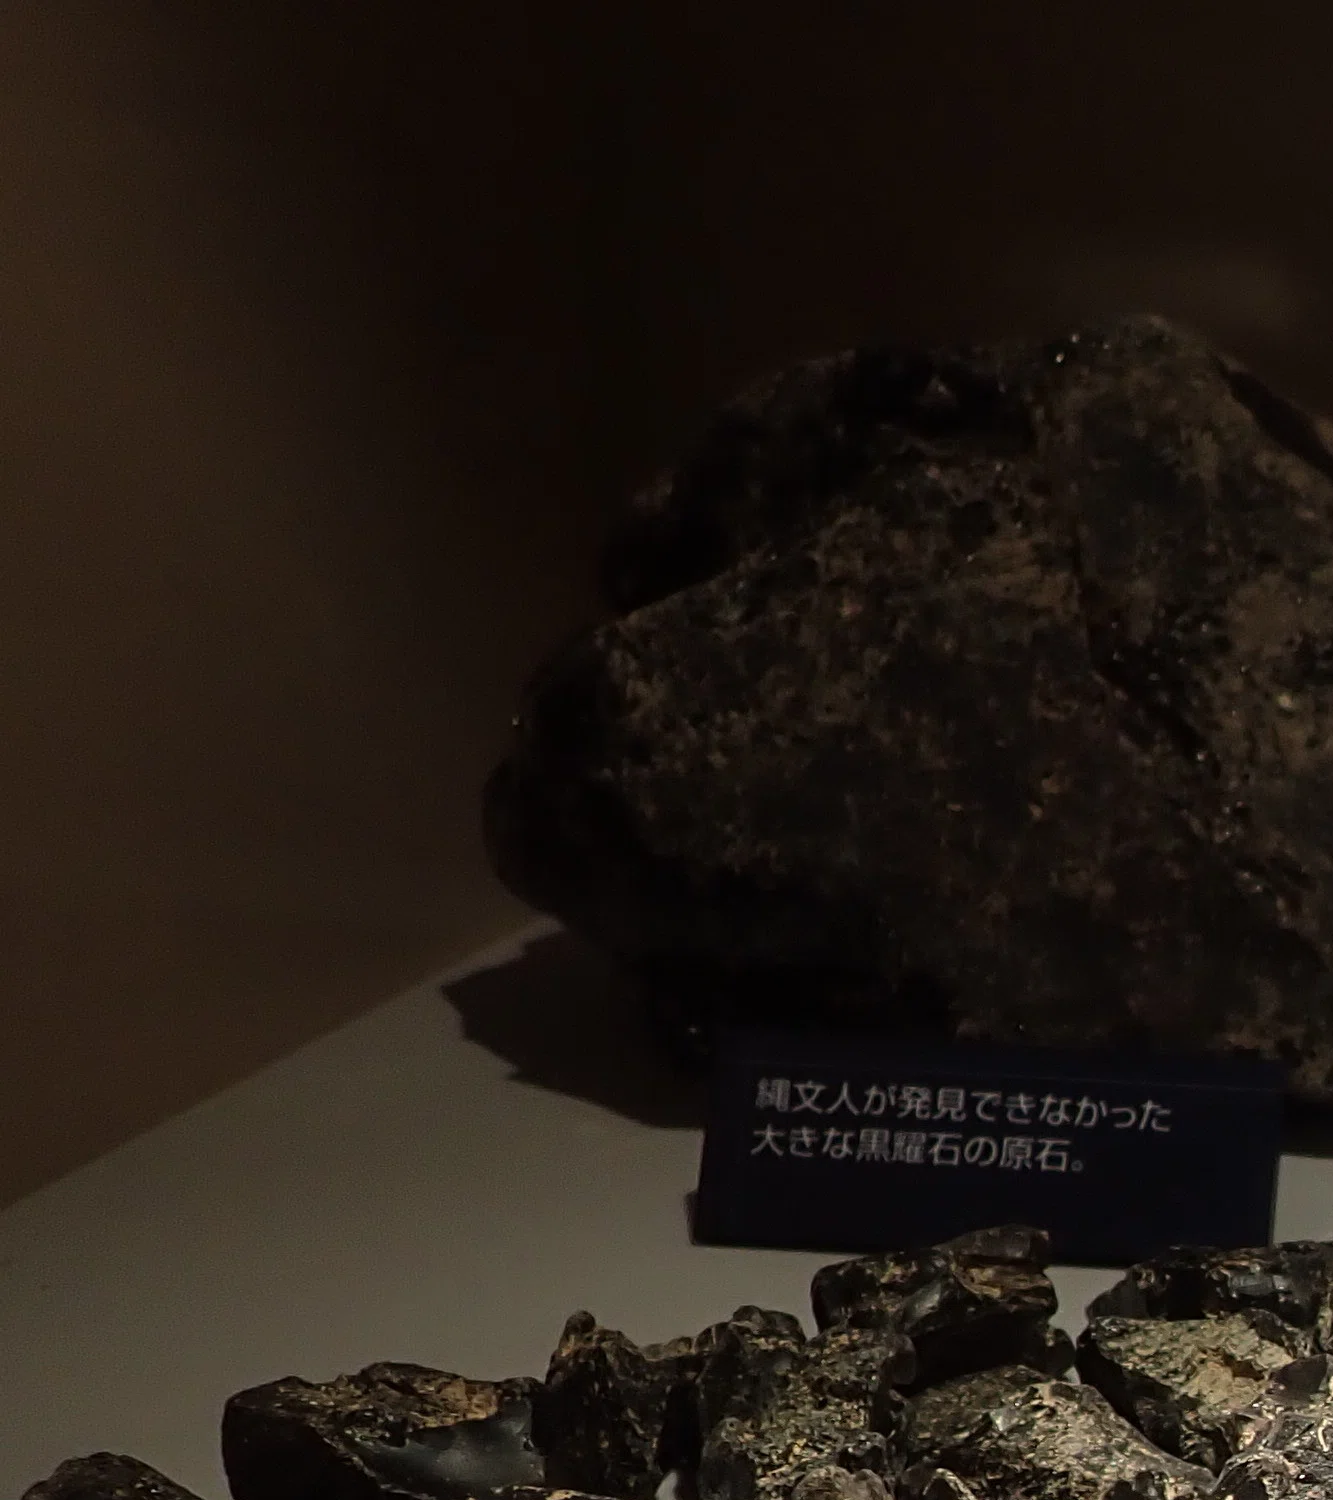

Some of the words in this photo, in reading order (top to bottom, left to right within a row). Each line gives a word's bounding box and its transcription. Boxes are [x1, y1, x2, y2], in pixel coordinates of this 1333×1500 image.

[754, 1077, 1173, 1134] 縄文人が発見できなかった
[750, 1125, 1085, 1174] 大きな黒耀石の原石。
